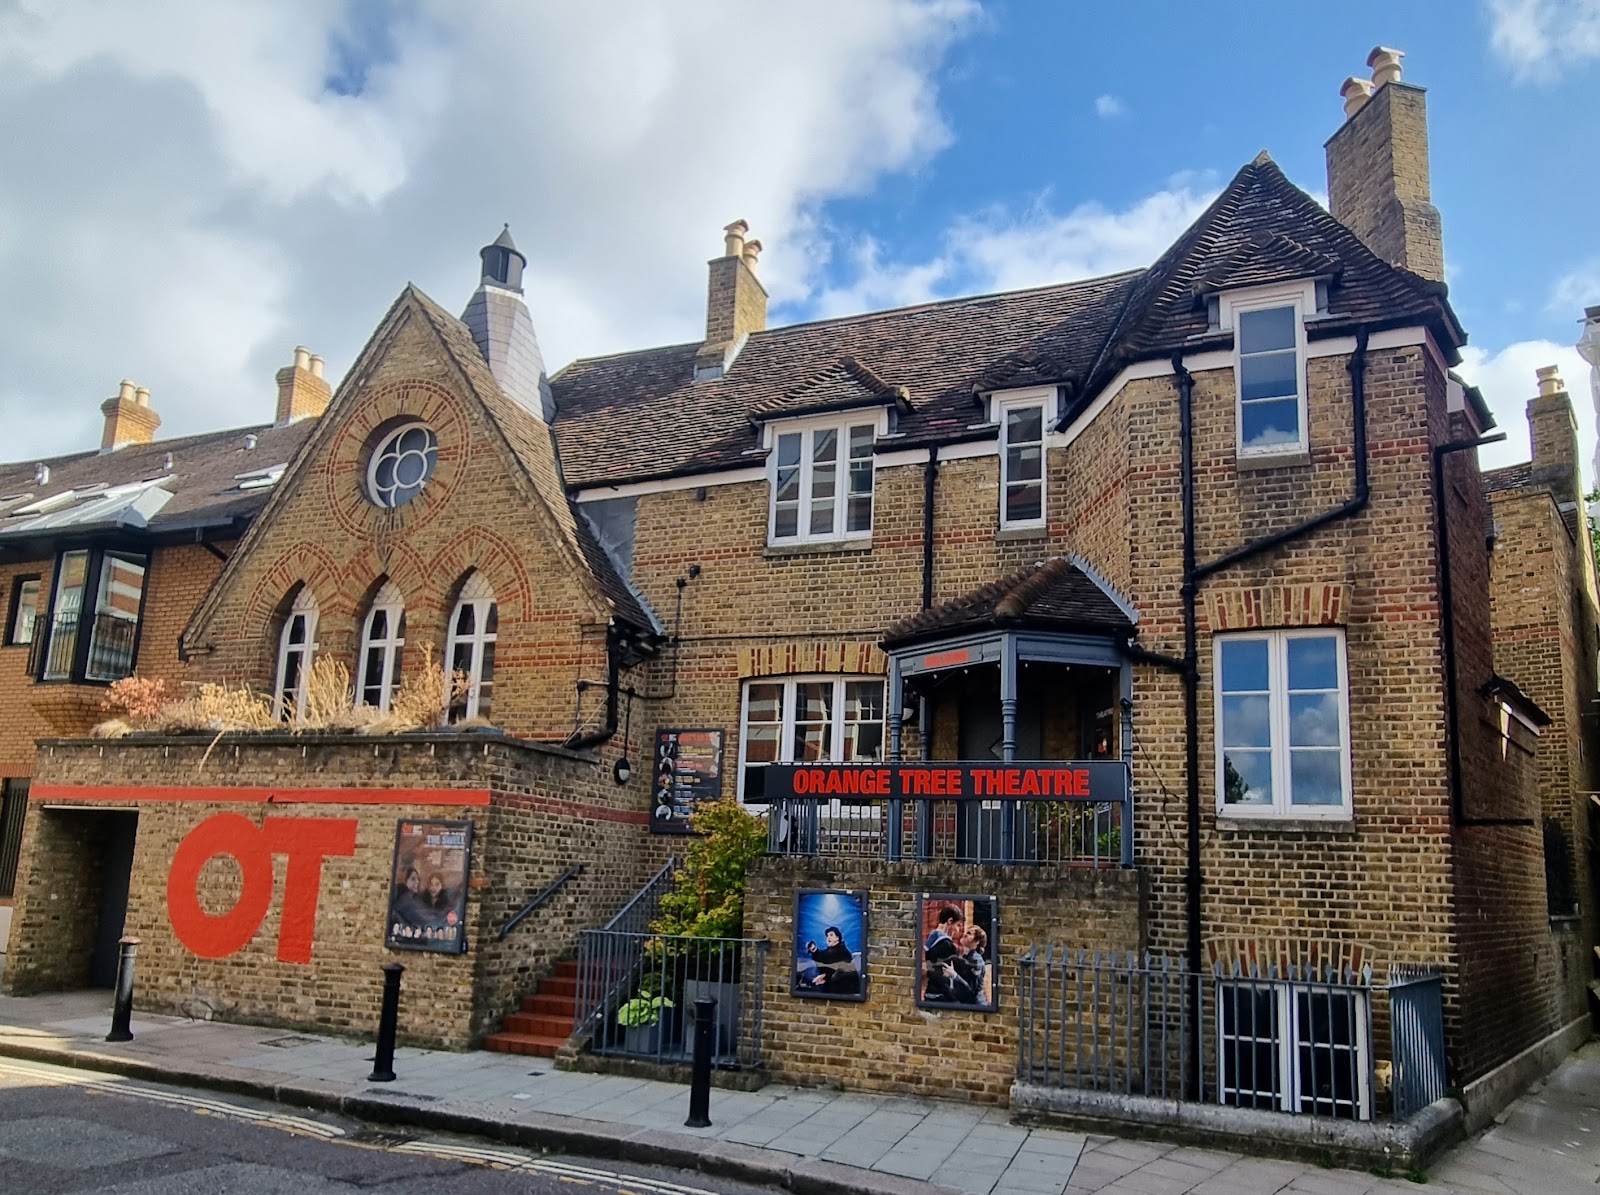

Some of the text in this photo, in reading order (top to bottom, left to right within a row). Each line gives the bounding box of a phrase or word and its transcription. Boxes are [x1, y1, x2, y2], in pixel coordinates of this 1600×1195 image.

[793, 769, 1090, 796] ORANGE TREE THEATRE
[167, 811, 359, 965] OT
